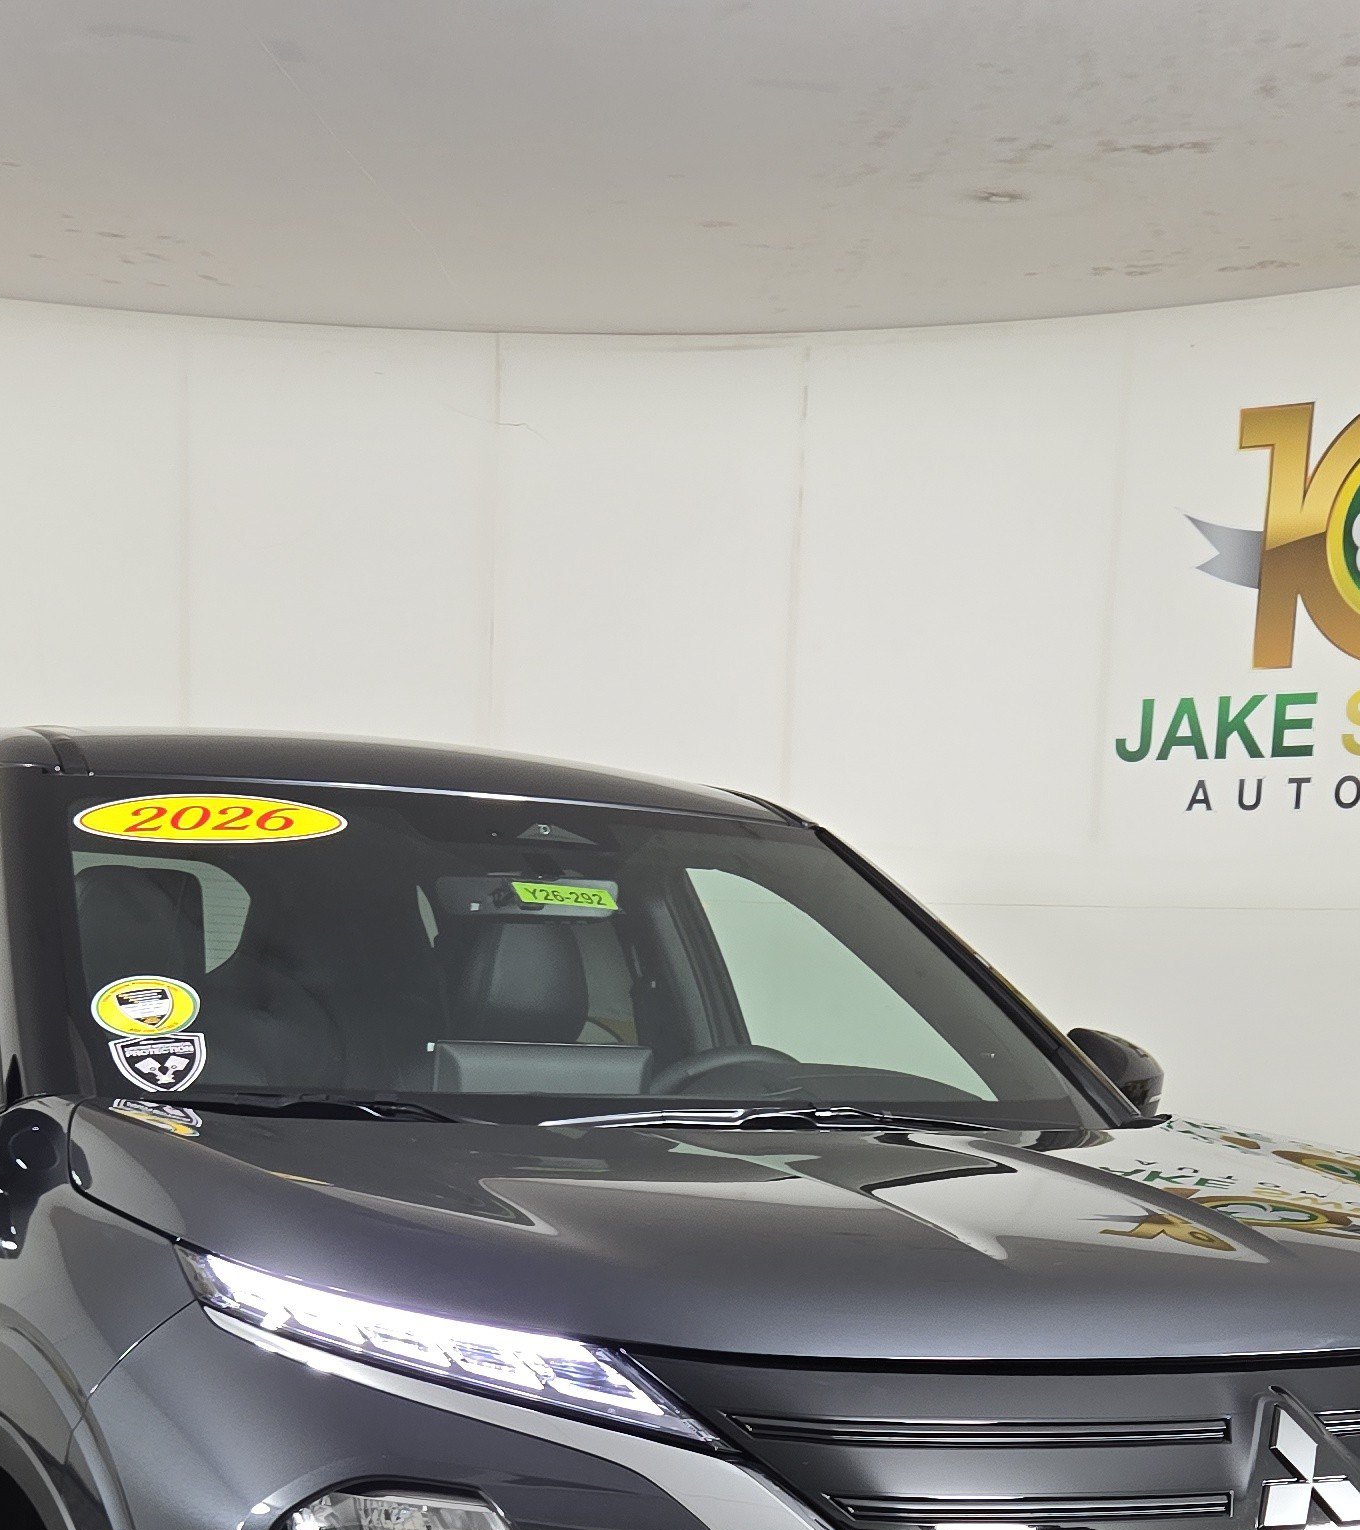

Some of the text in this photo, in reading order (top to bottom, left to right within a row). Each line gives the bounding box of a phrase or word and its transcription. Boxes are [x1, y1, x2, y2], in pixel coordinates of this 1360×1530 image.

[1115, 691, 1318, 763] JAKE
[123, 805, 301, 833] 2026
[523, 887, 607, 906] Y26-292
